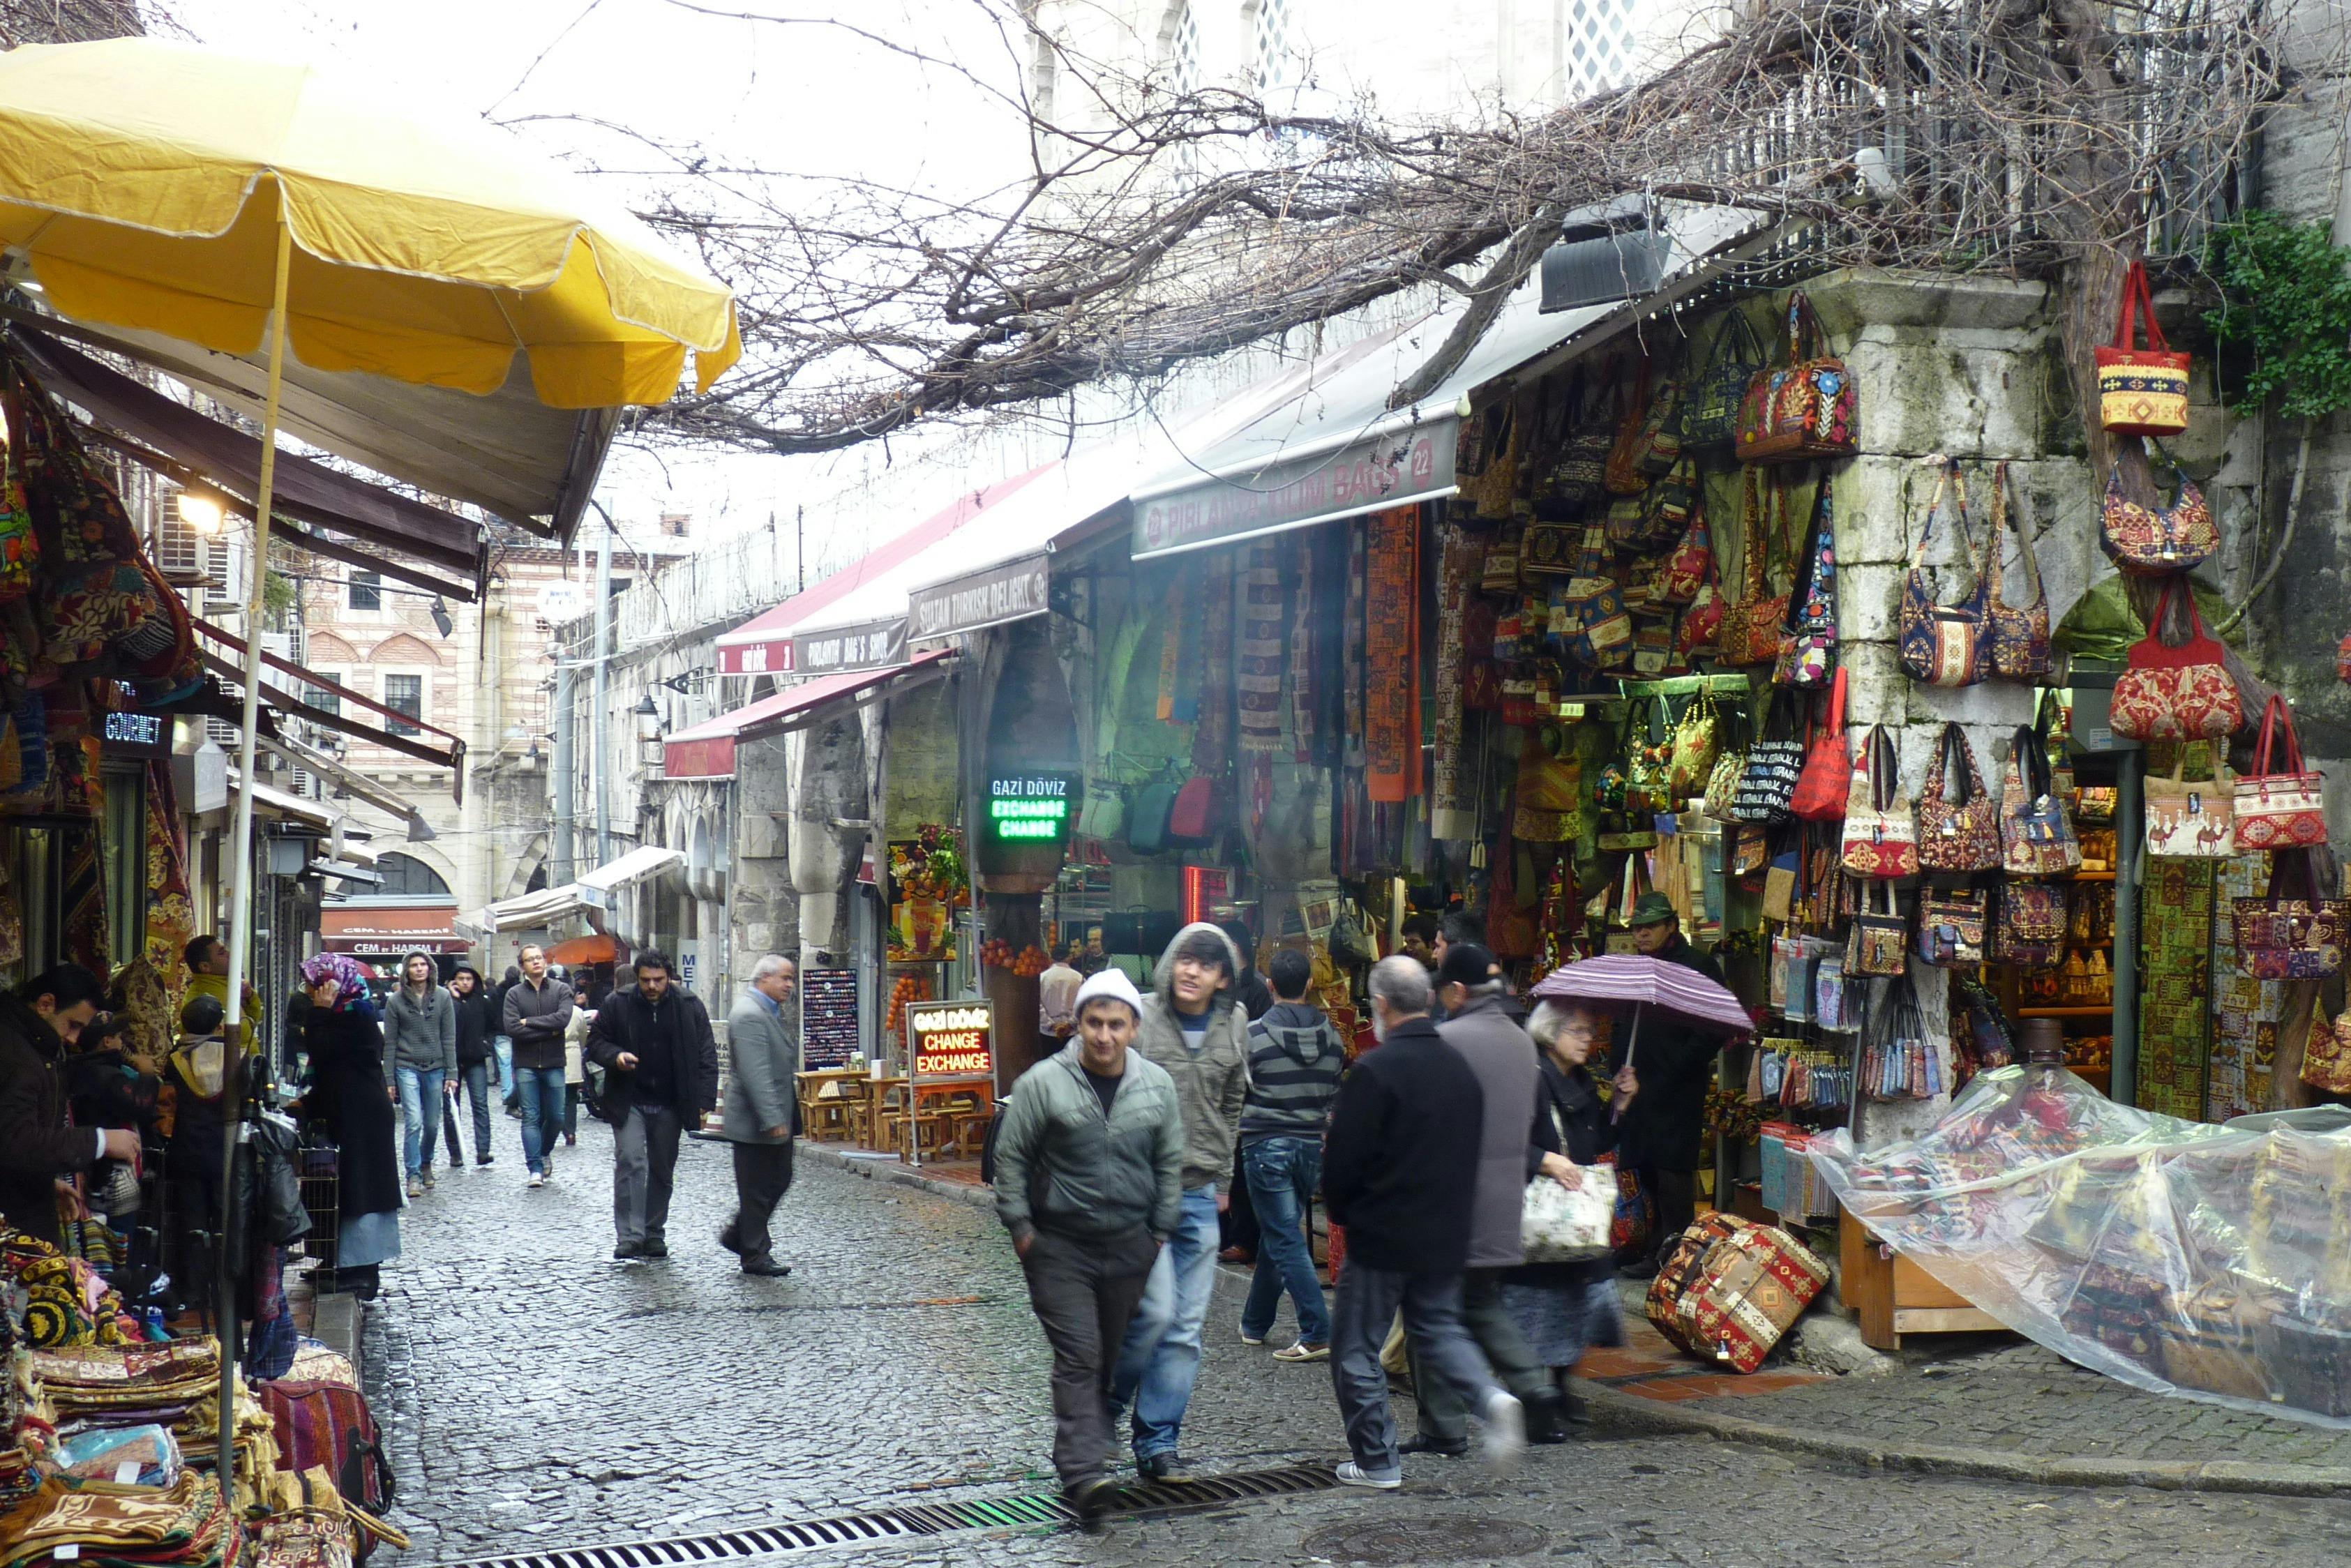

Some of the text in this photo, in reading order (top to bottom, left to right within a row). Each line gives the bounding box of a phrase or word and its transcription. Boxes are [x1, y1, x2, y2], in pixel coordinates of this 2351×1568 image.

[1333, 455, 1399, 504] BAGS
[1414, 449, 1428, 476] 22
[919, 596, 950, 633] SULTAN
[952, 586, 988, 625] TURKISH
[991, 573, 1030, 615] DELIGHT
[106, 712, 162, 744] GOURMET
[993, 777, 1066, 795] GAZİ DÖVİZ
[991, 799, 1065, 817] EXCHANGE
[999, 820, 1056, 837] CHANGE
[354, 943, 379, 953] CEM
[914, 1007, 989, 1032] GAZİ DÖVİZ
[924, 1032, 981, 1051] CHANGE
[917, 1053, 990, 1072] EXCHANGE
